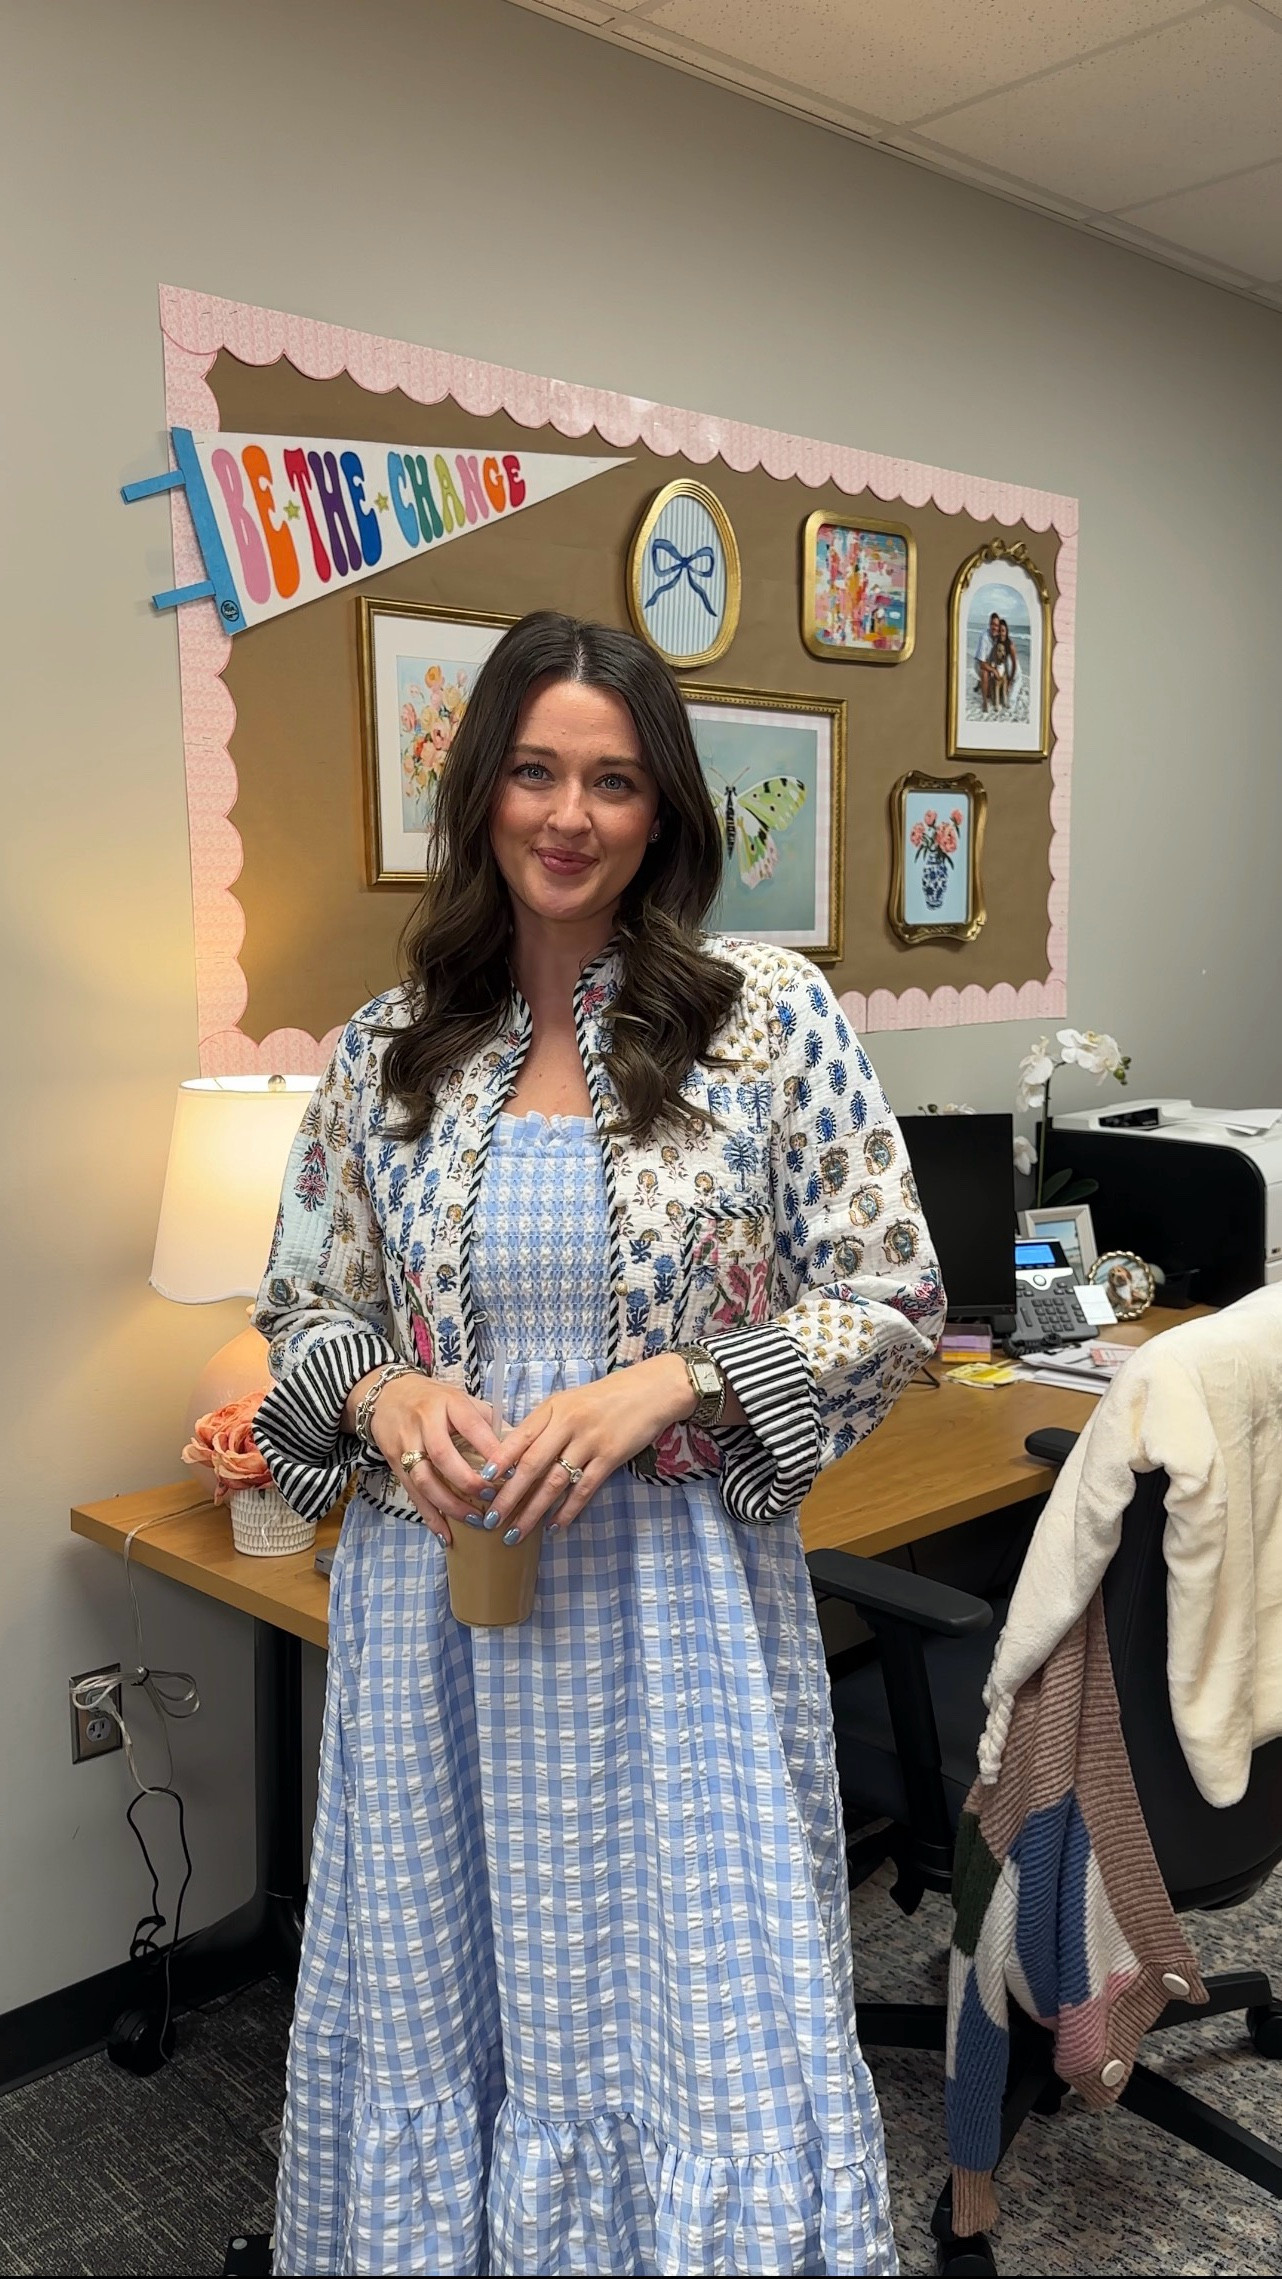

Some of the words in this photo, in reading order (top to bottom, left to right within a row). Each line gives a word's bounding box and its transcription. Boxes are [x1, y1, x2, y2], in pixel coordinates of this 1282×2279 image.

[211, 445, 300, 604] BE
[284, 448, 382, 583] THE
[387, 451, 526, 548] CHANGE
